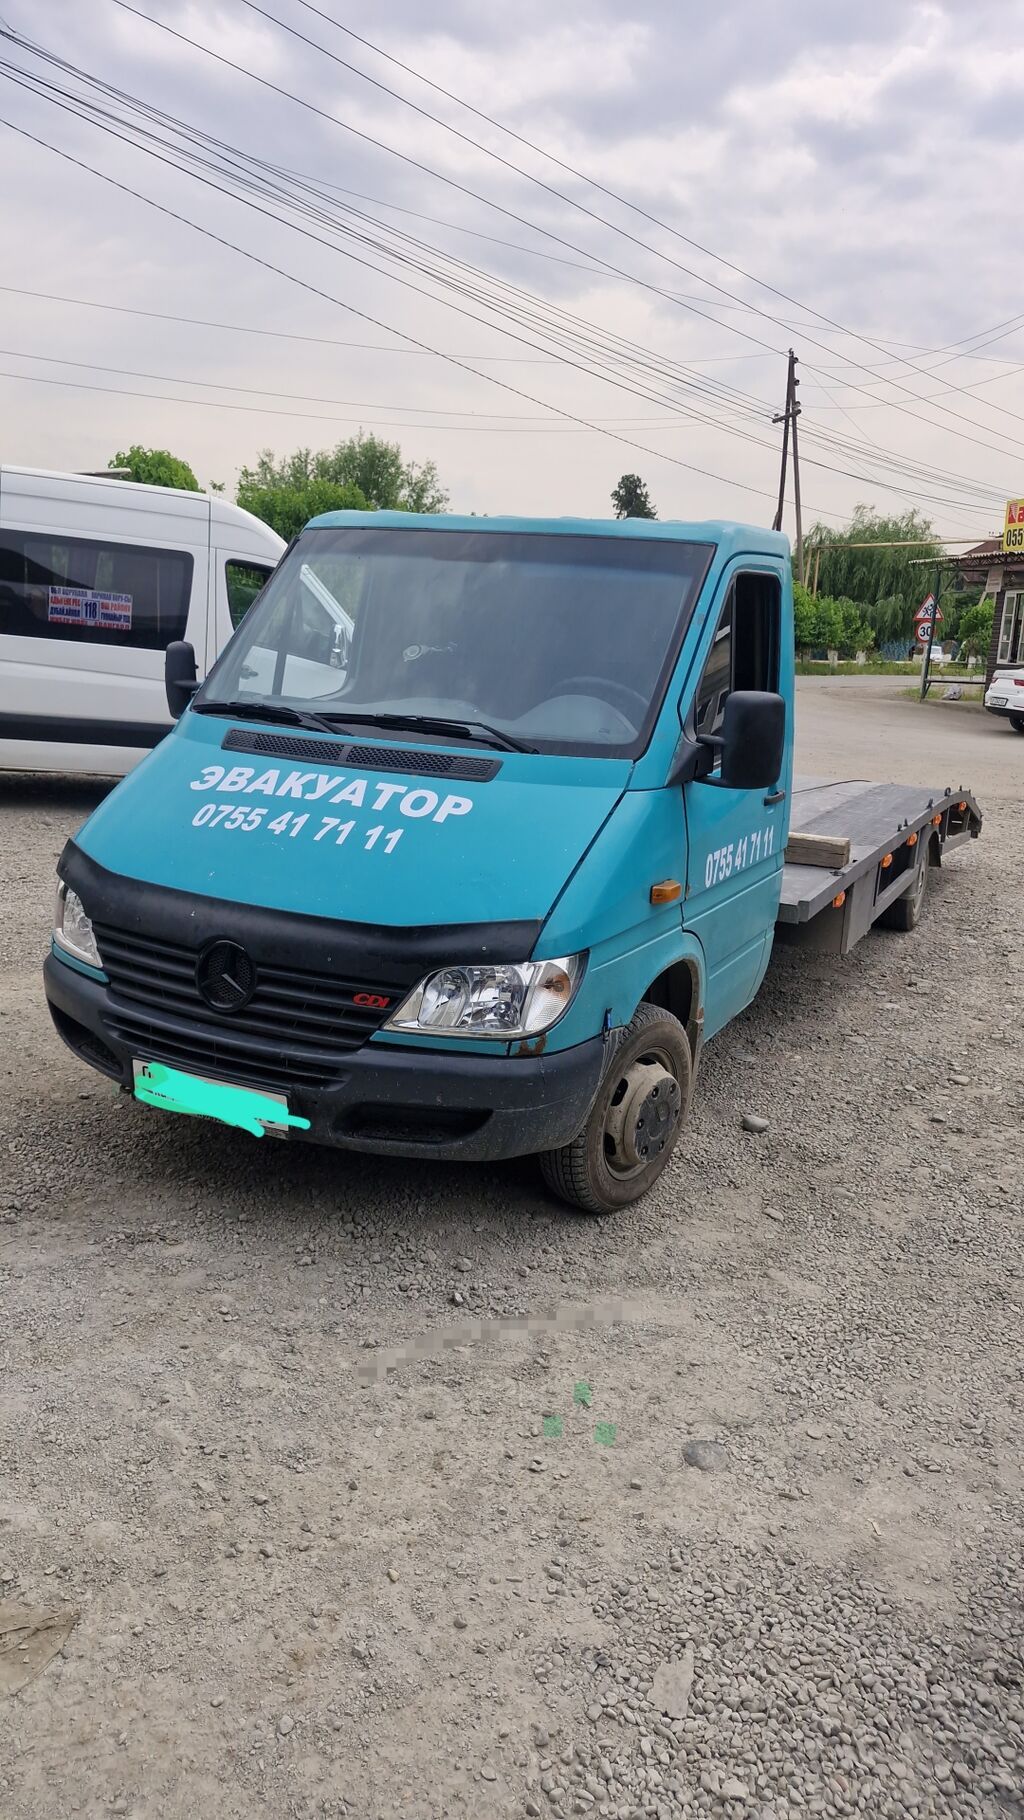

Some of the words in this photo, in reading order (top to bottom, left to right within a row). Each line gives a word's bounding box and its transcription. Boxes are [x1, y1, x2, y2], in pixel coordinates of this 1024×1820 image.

[1006, 528, 1024, 546] 055
[84, 602, 97, 619] 118
[919, 626, 932, 637] 30
[190, 765, 474, 824] ЭВАКУАТОР
[191, 803, 269, 832] 0755
[266, 810, 310, 838] 41
[312, 816, 357, 846] 71
[363, 825, 405, 854] 11
[704, 843, 734, 889] 0755
[734, 835, 748, 871] 41
[749, 829, 762, 865] 71
[763, 824, 774, 857] 11
[352, 992, 391, 1009] CDI
